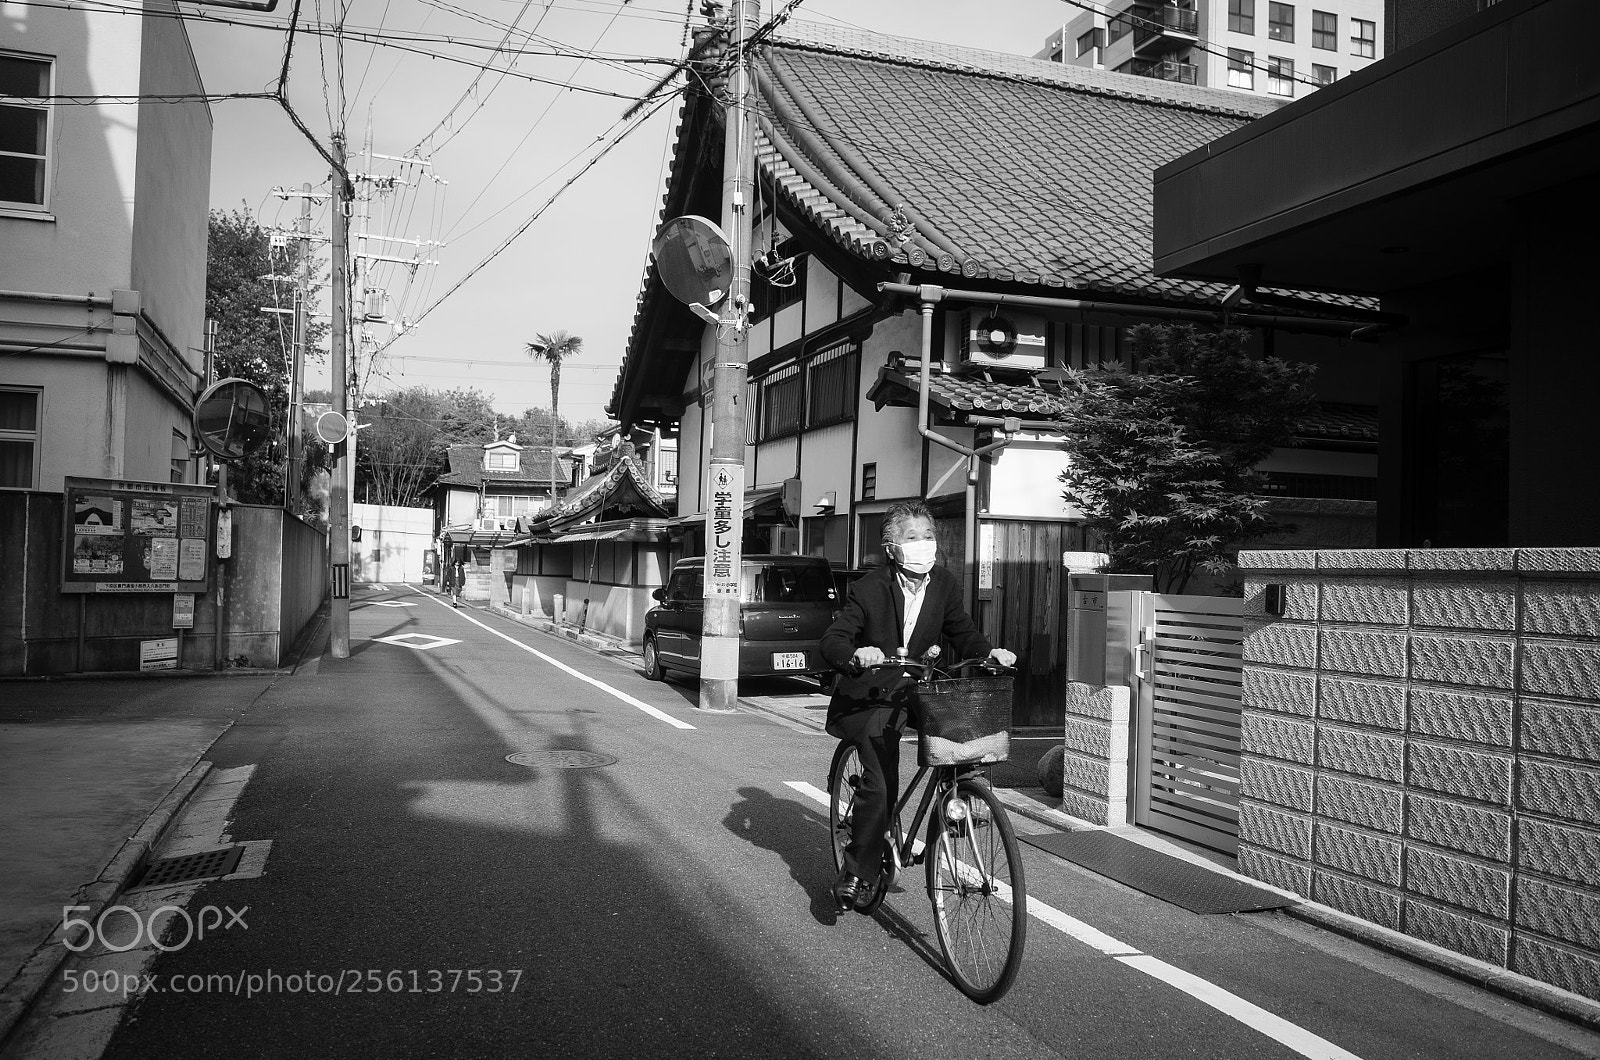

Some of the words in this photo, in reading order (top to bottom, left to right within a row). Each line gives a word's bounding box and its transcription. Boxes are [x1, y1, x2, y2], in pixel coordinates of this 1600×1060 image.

[712, 491, 732, 577] 学童多し注意
[782, 659, 804, 668] 16-16
